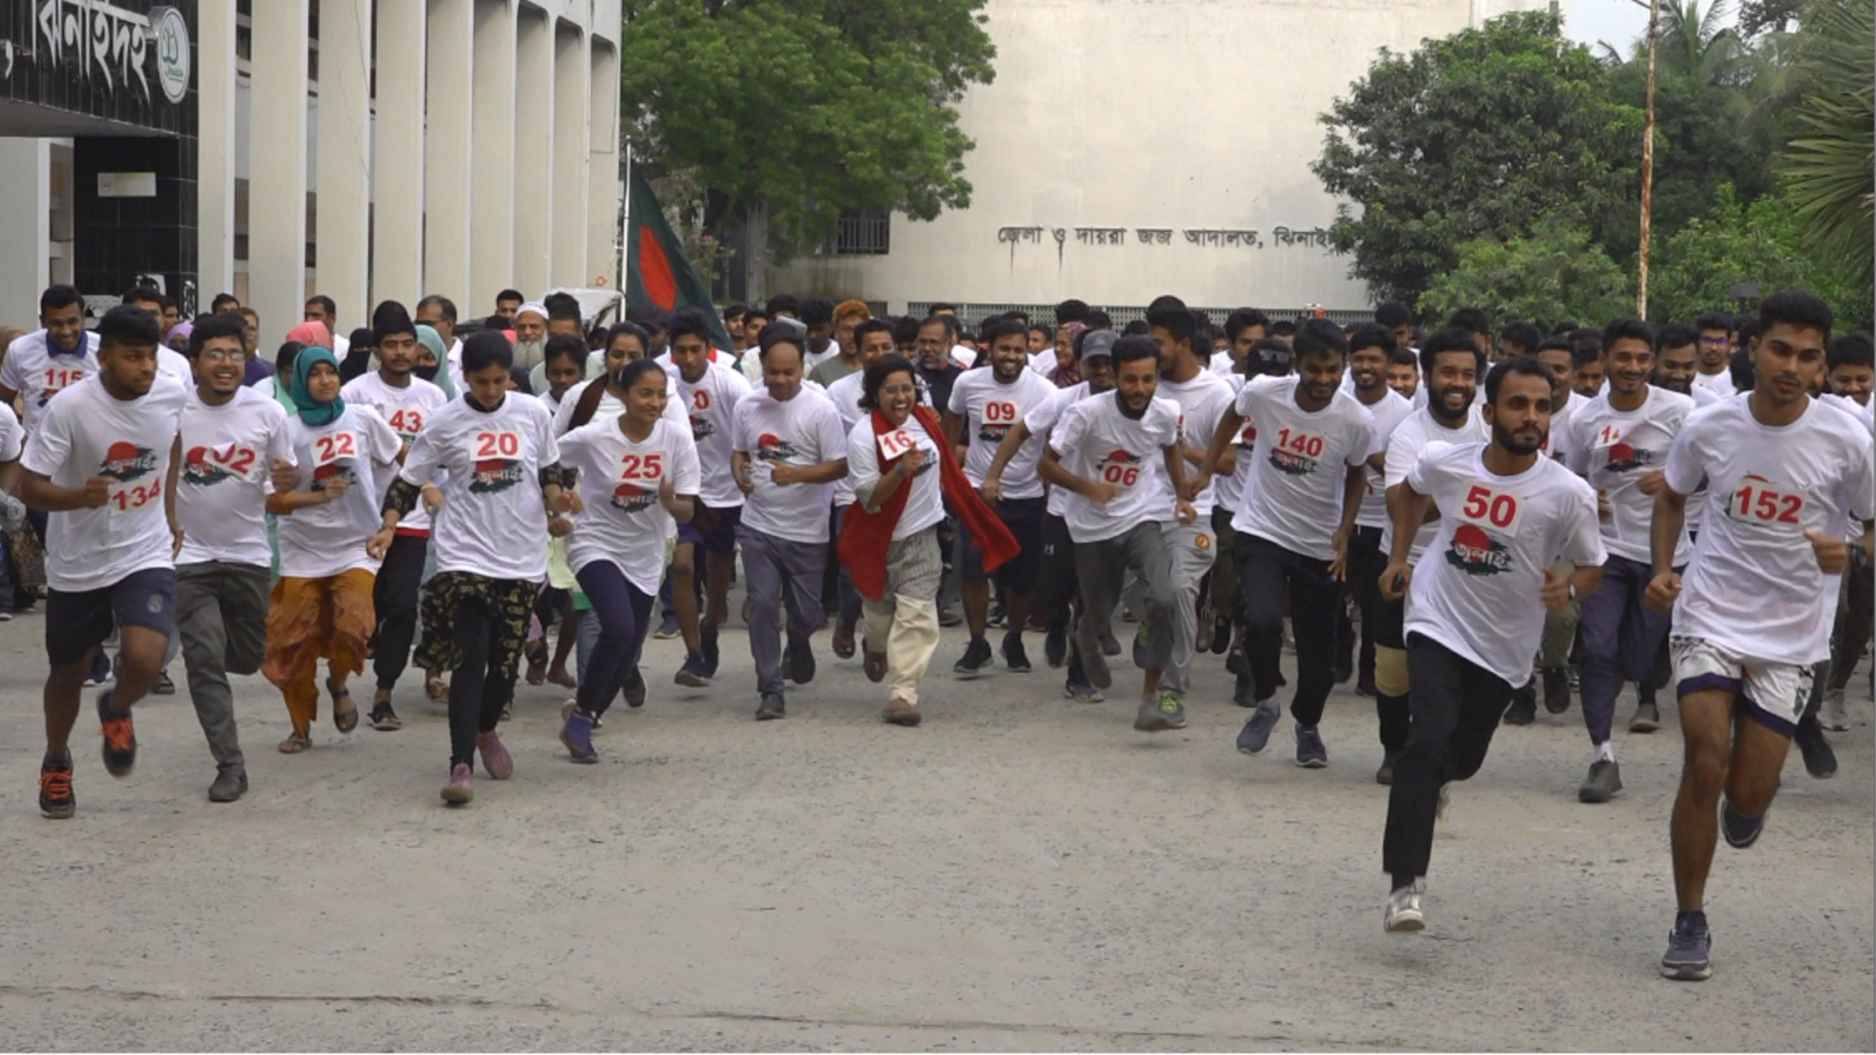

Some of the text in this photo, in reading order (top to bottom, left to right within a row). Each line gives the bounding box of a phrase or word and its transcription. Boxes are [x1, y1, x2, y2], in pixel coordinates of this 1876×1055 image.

[998, 226, 1332, 249] জেলা ও দায়রা জজ আদালত, ঝিনাই
[390, 409, 421, 432] 43
[986, 402, 1015, 421] 09
[316, 432, 354, 462] 22
[477, 431, 518, 456] 20
[883, 430, 913, 453] 16
[1279, 428, 1322, 457] 140
[622, 454, 662, 479] 25
[1105, 465, 1138, 487] 06
[112, 477, 160, 511] 134
[1736, 485, 1802, 524] 152
[1464, 485, 1517, 529] 50
